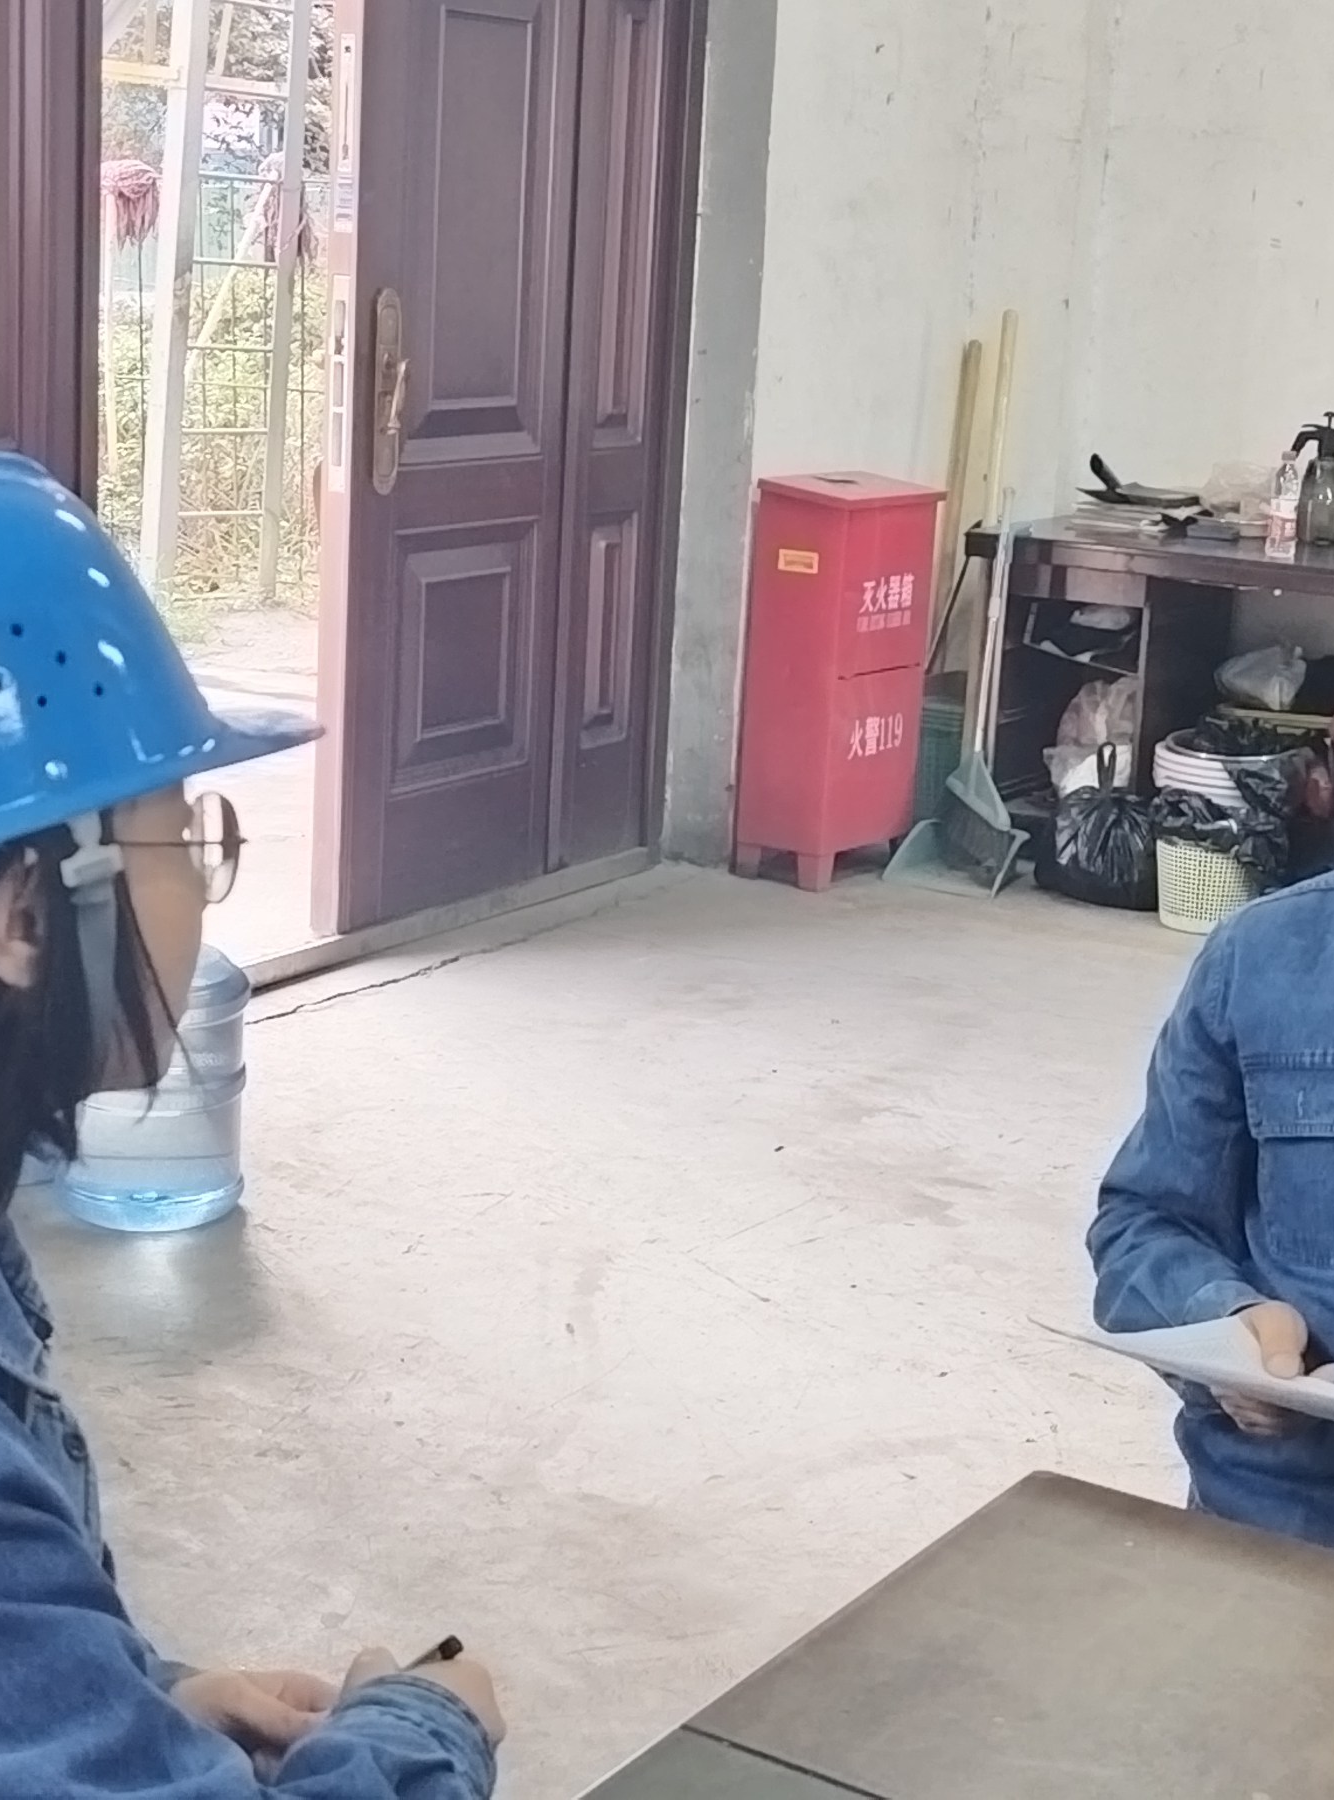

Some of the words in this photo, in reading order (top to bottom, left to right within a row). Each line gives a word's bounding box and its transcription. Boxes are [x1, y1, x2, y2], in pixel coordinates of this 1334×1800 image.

[857, 571, 916, 614] 灭火器箱
[847, 712, 904, 760] 火警119
